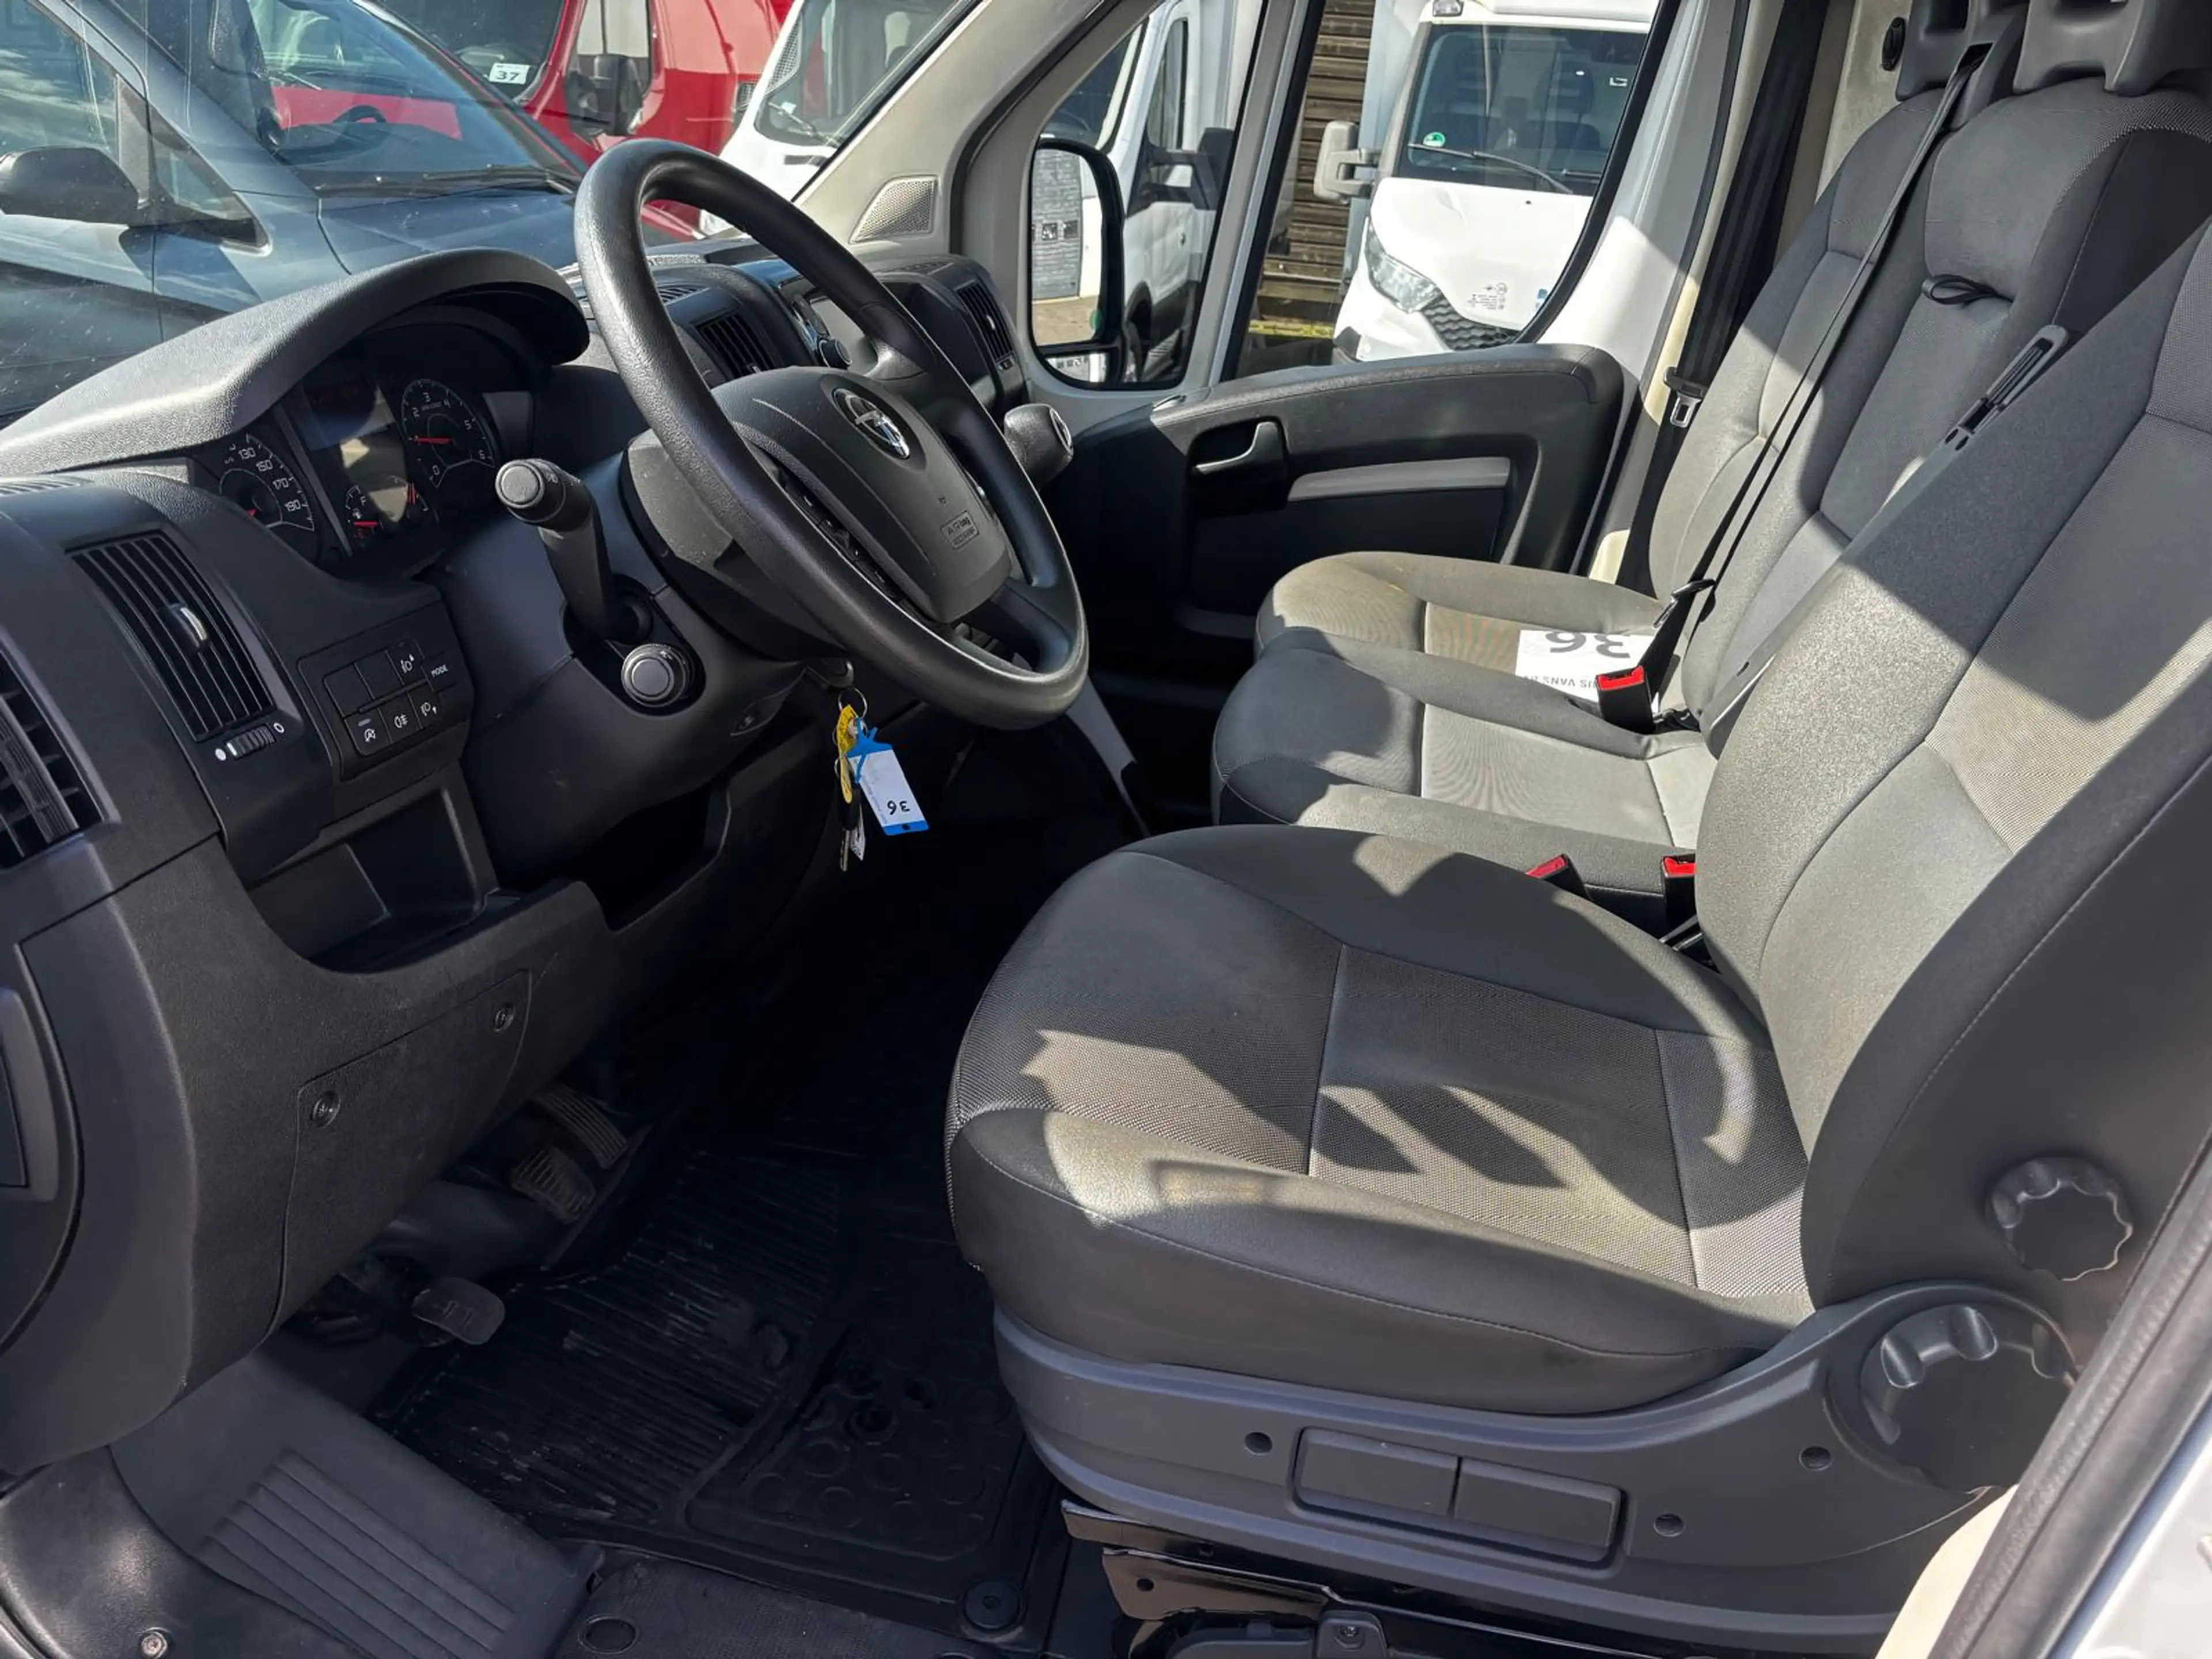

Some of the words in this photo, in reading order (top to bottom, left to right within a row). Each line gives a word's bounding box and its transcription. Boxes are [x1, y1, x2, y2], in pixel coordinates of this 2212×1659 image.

[496, 70, 520, 81] 37
[464, 420, 471, 430] 5
[238, 447, 256, 460] 130
[272, 478, 289, 490] 170
[1546, 632, 1631, 658] 36
[431, 664, 449, 678] MODE
[887, 800, 910, 815] 36
